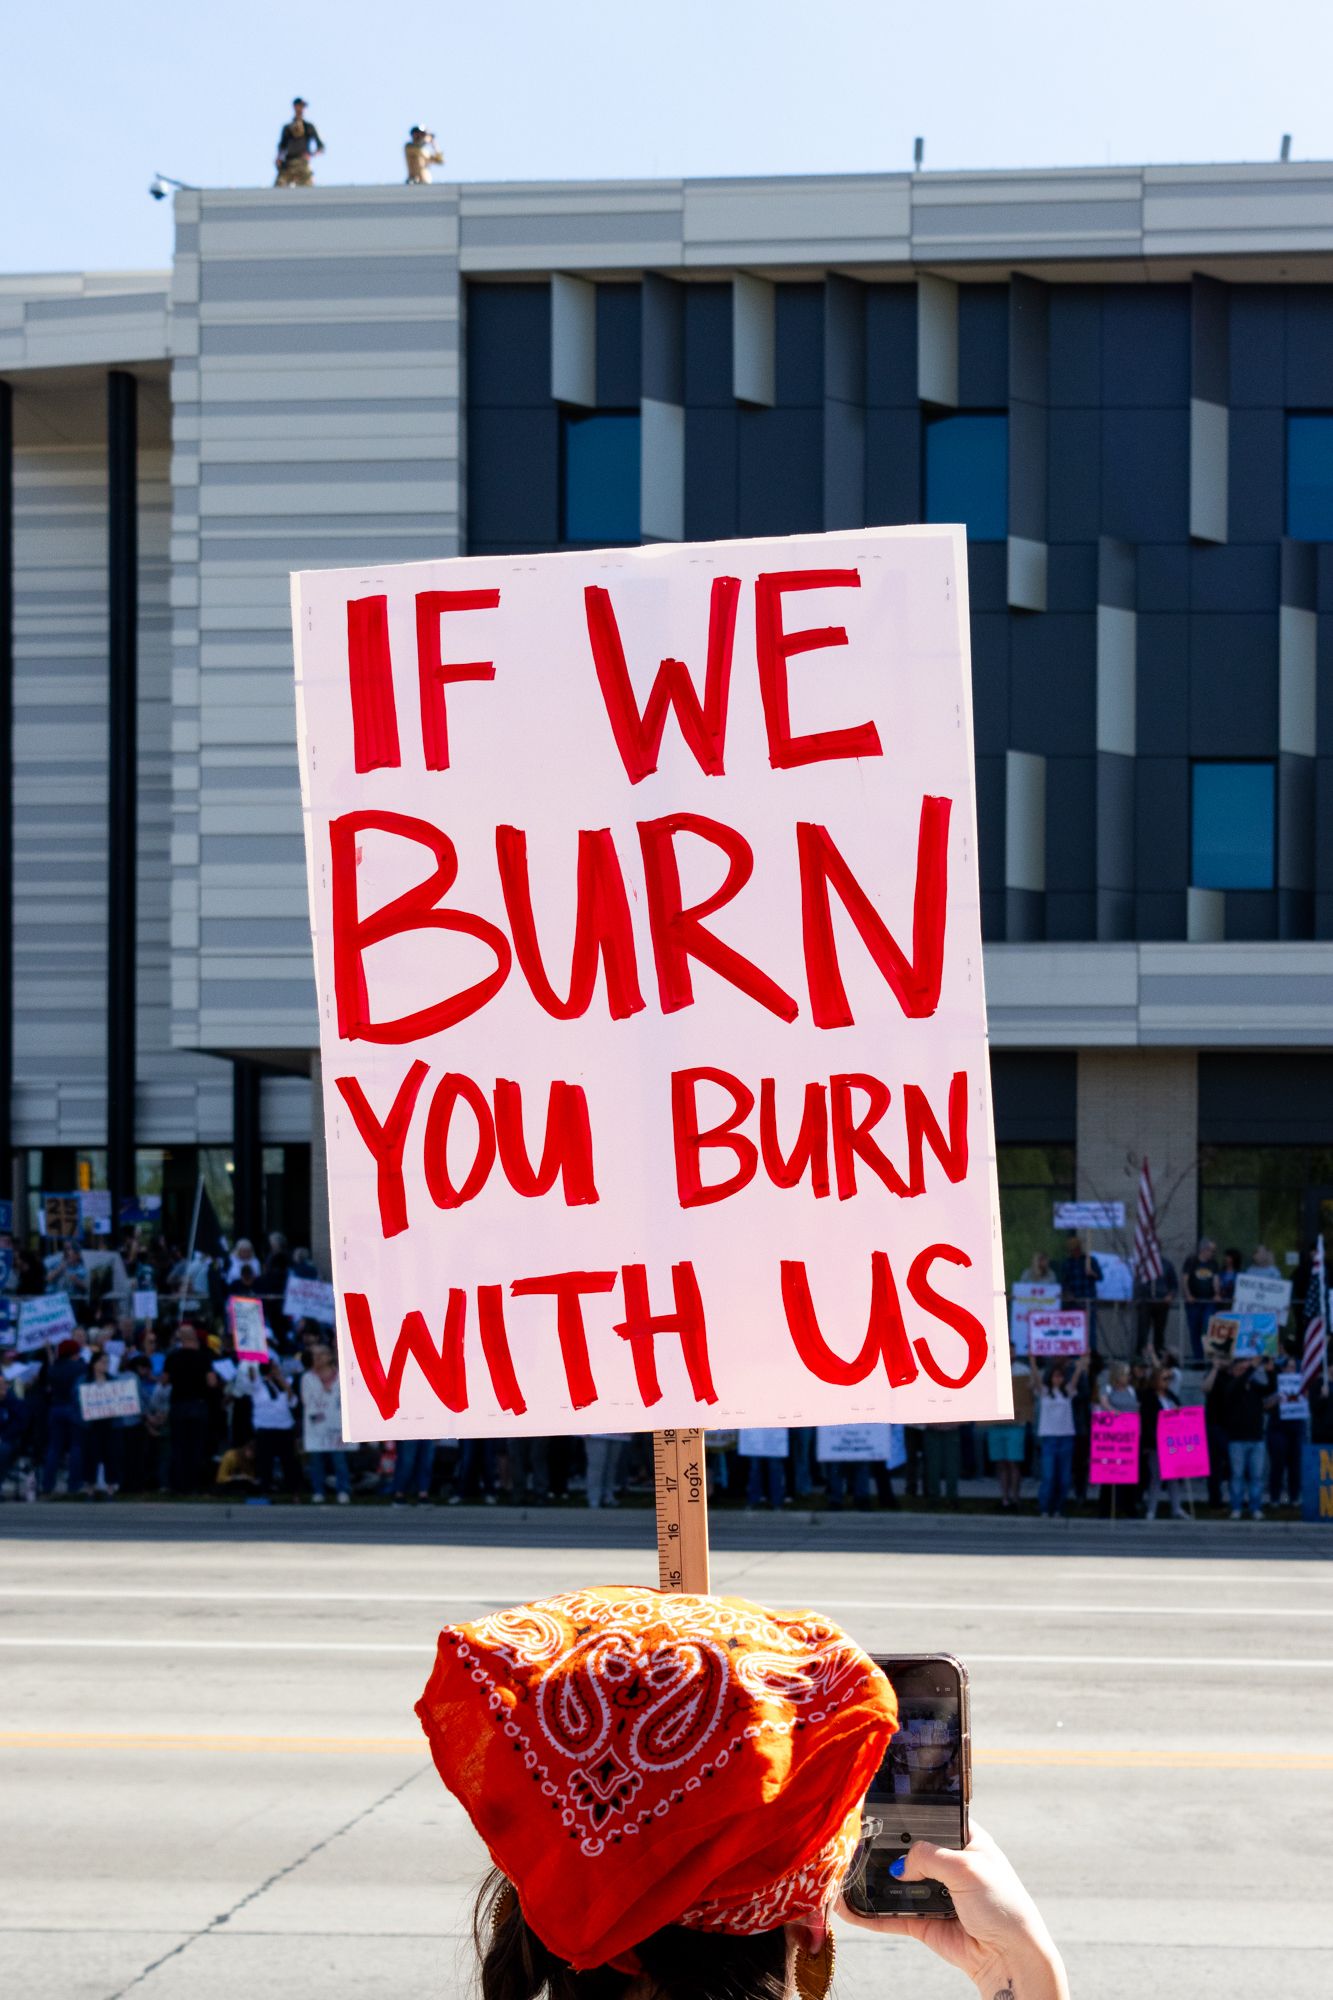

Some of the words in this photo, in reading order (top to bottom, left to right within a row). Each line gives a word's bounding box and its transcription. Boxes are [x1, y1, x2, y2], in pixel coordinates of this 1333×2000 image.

[347, 589, 500, 774] IF
[585, 569, 883, 785] WE
[329, 795, 952, 1044] BURN
[335, 1060, 599, 1239] YOU
[672, 1067, 968, 1209] BURN
[344, 1261, 718, 1420] WITH
[780, 1244, 988, 1389] US
[664, 1429, 675, 1445] 18
[666, 1477, 677, 1493] 17
[668, 1523, 679, 1540] 16
[670, 1570, 681, 1588] 15
